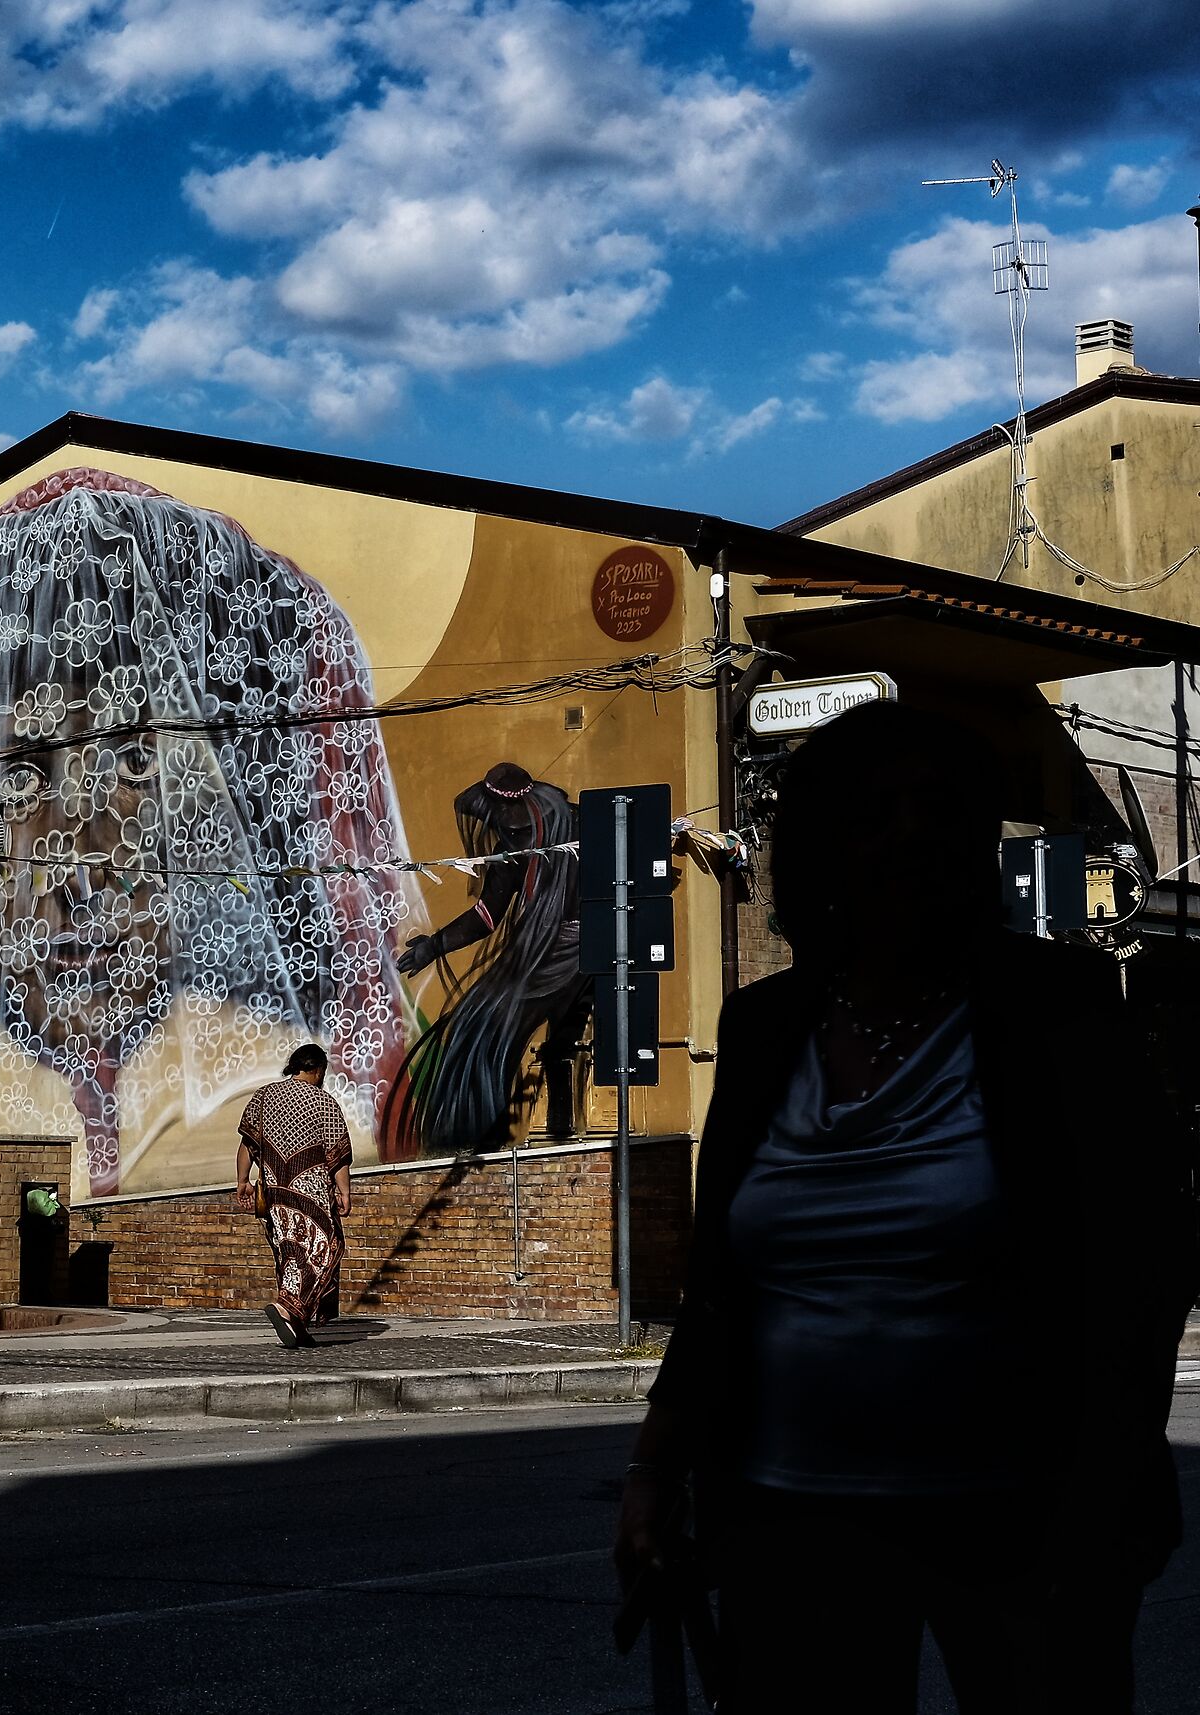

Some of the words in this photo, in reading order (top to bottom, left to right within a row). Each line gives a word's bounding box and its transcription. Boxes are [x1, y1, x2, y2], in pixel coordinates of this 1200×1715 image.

[610, 589, 625, 604] Pro
[626, 588, 652, 603] Loco
[608, 605, 650, 619] Tricarico
[616, 619, 642, 635] 2023
[755, 697, 811, 722] Golden
[1103, 938, 1143, 961] ower
